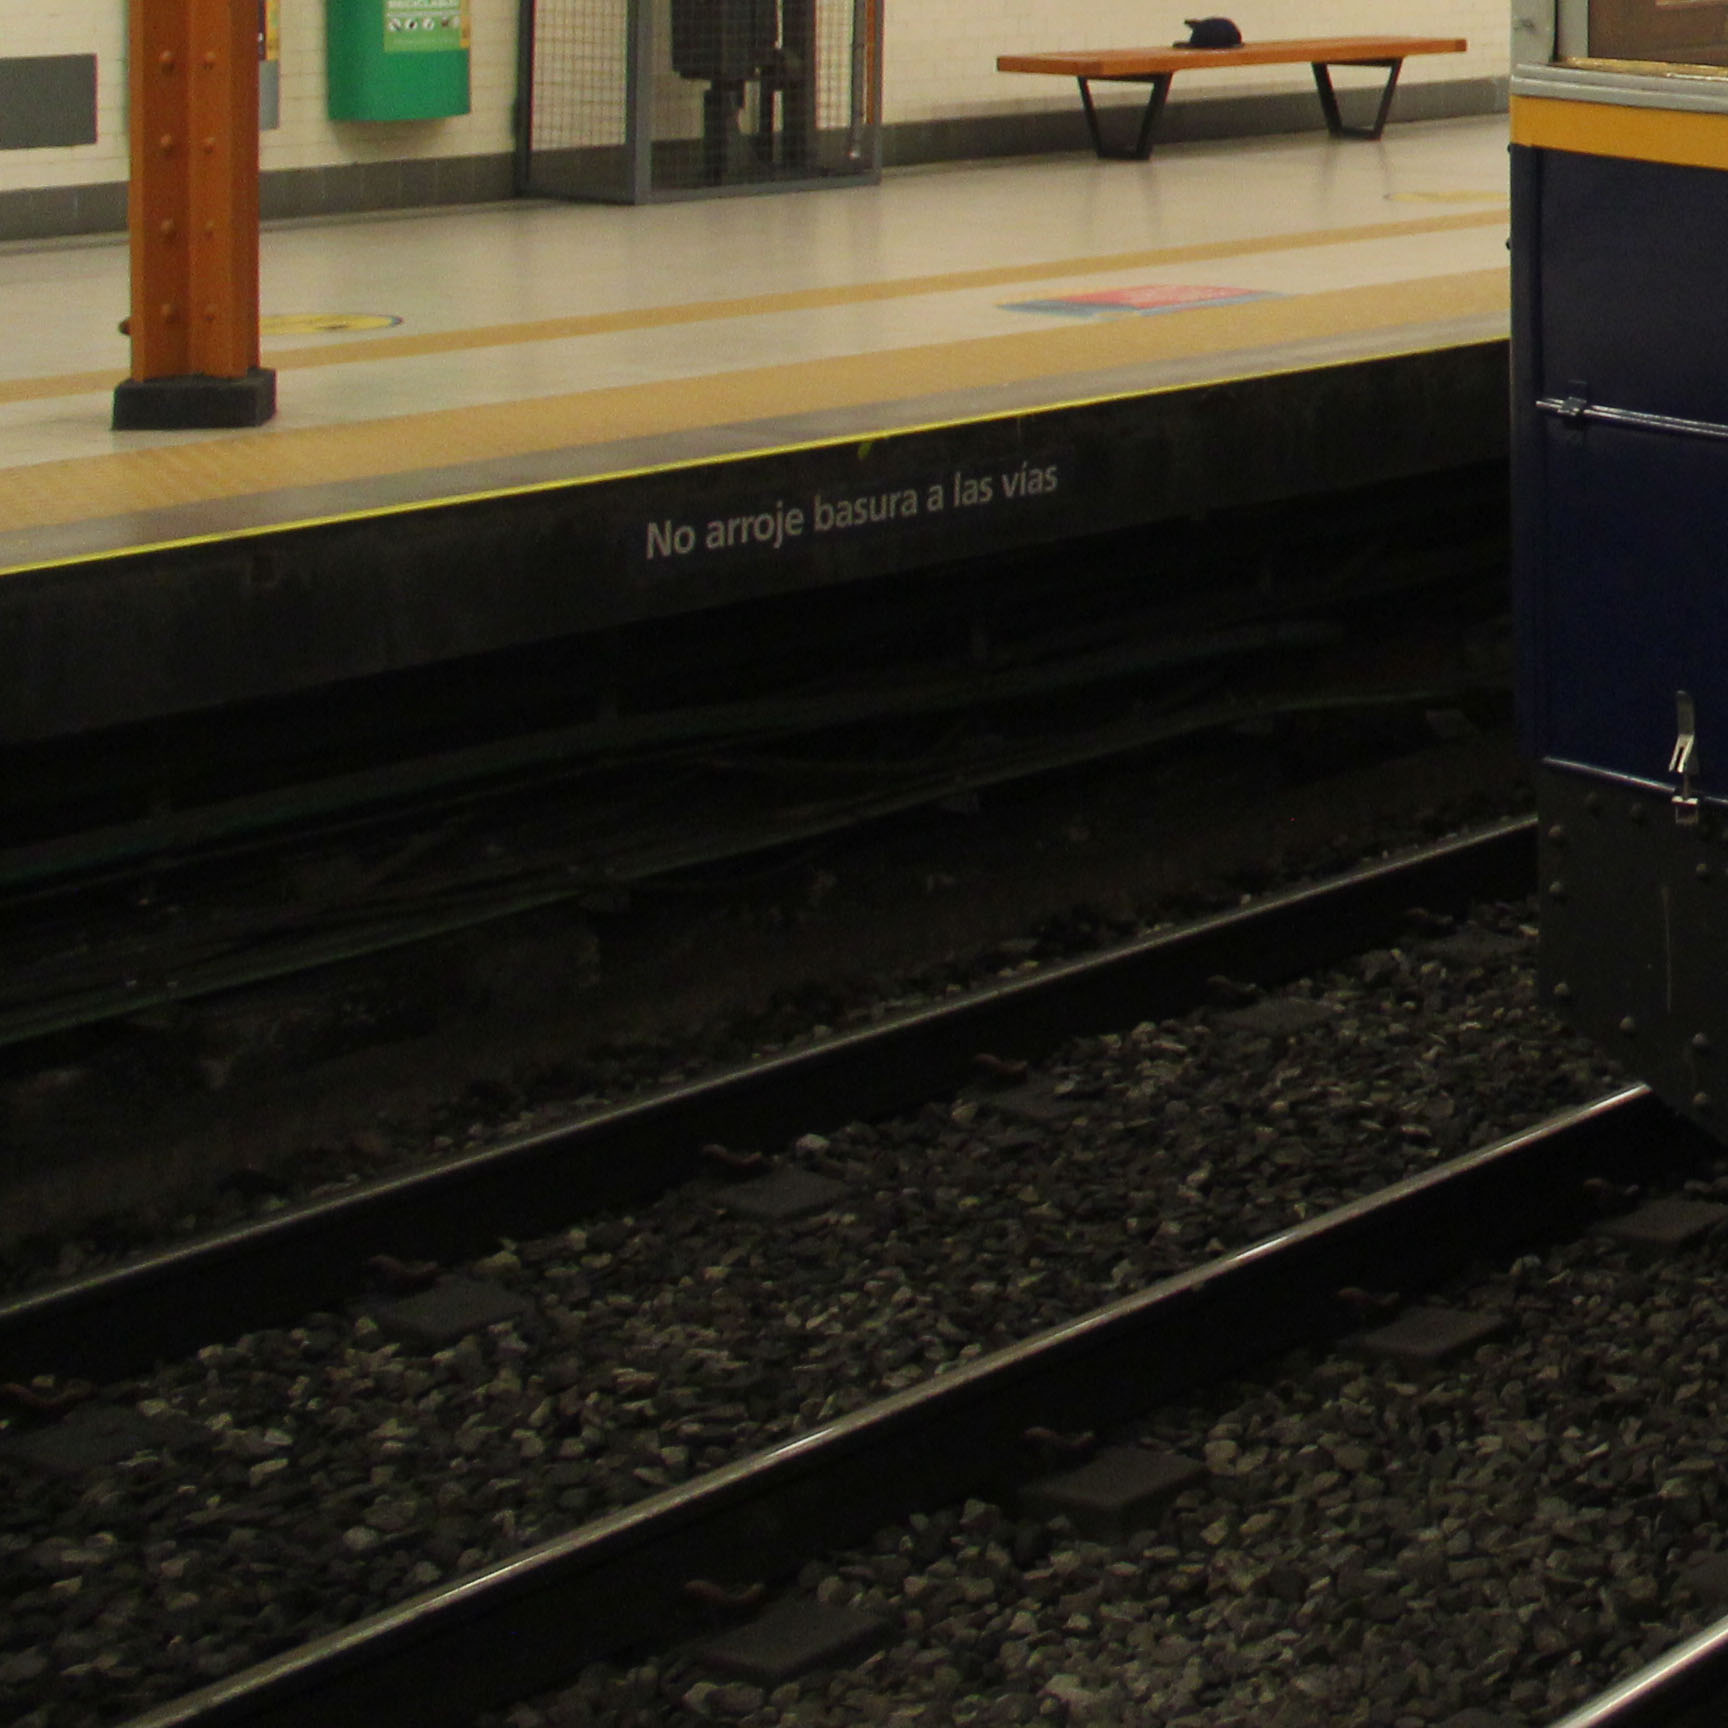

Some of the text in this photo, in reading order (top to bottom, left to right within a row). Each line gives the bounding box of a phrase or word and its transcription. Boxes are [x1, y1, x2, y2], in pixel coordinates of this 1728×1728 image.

[645, 461, 1059, 560] No arroje basura a las vías
